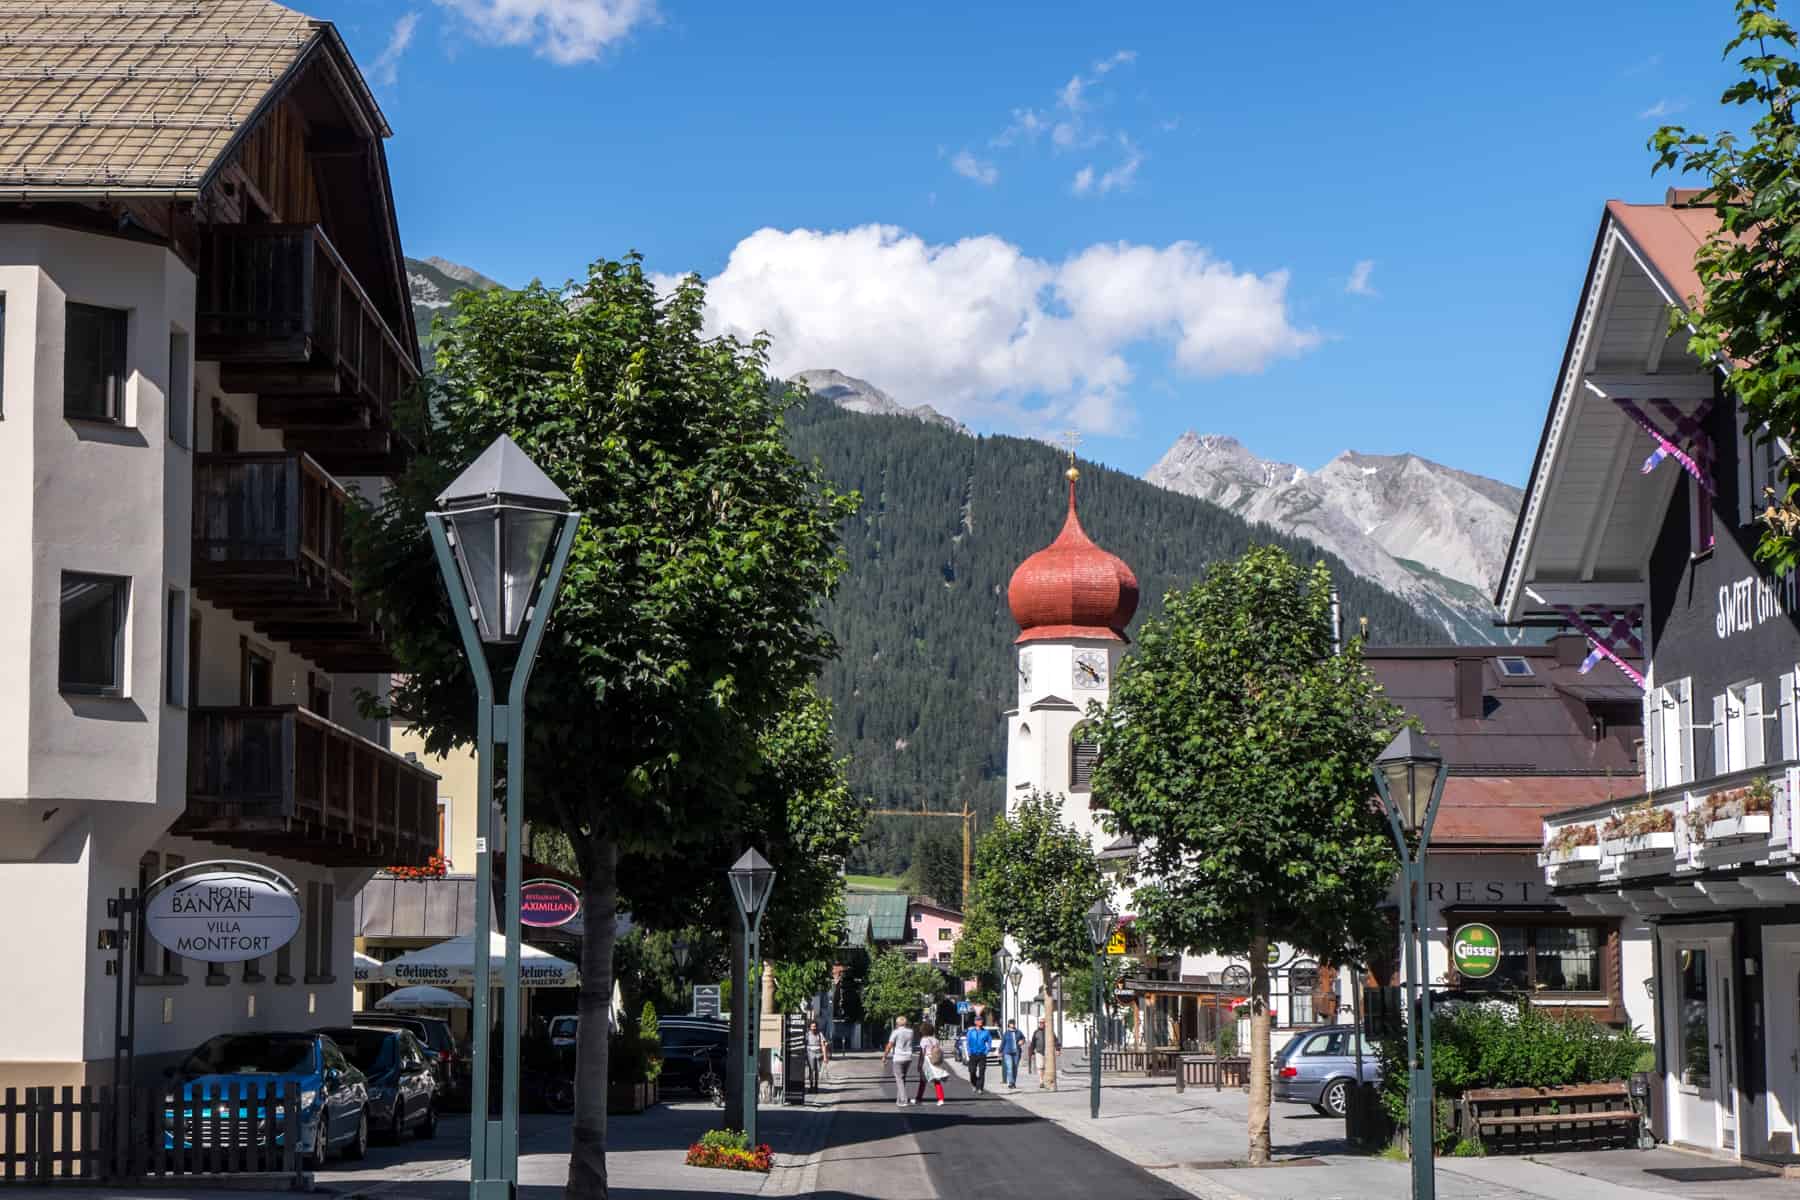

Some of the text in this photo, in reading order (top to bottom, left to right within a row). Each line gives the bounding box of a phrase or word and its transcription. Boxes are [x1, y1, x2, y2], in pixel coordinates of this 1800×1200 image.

[1716, 576, 1753, 639] SWEET
[208, 887, 255, 899] HOTEL
[1426, 881, 1555, 902] REST
[172, 898, 251, 913] BANYAN
[521, 902, 573, 912] AXIMILIAN
[207, 921, 241, 933] VILLA
[177, 936, 271, 951] MONTFORT
[395, 964, 449, 978] Edelweiss
[520, 964, 563, 978] delweiss
